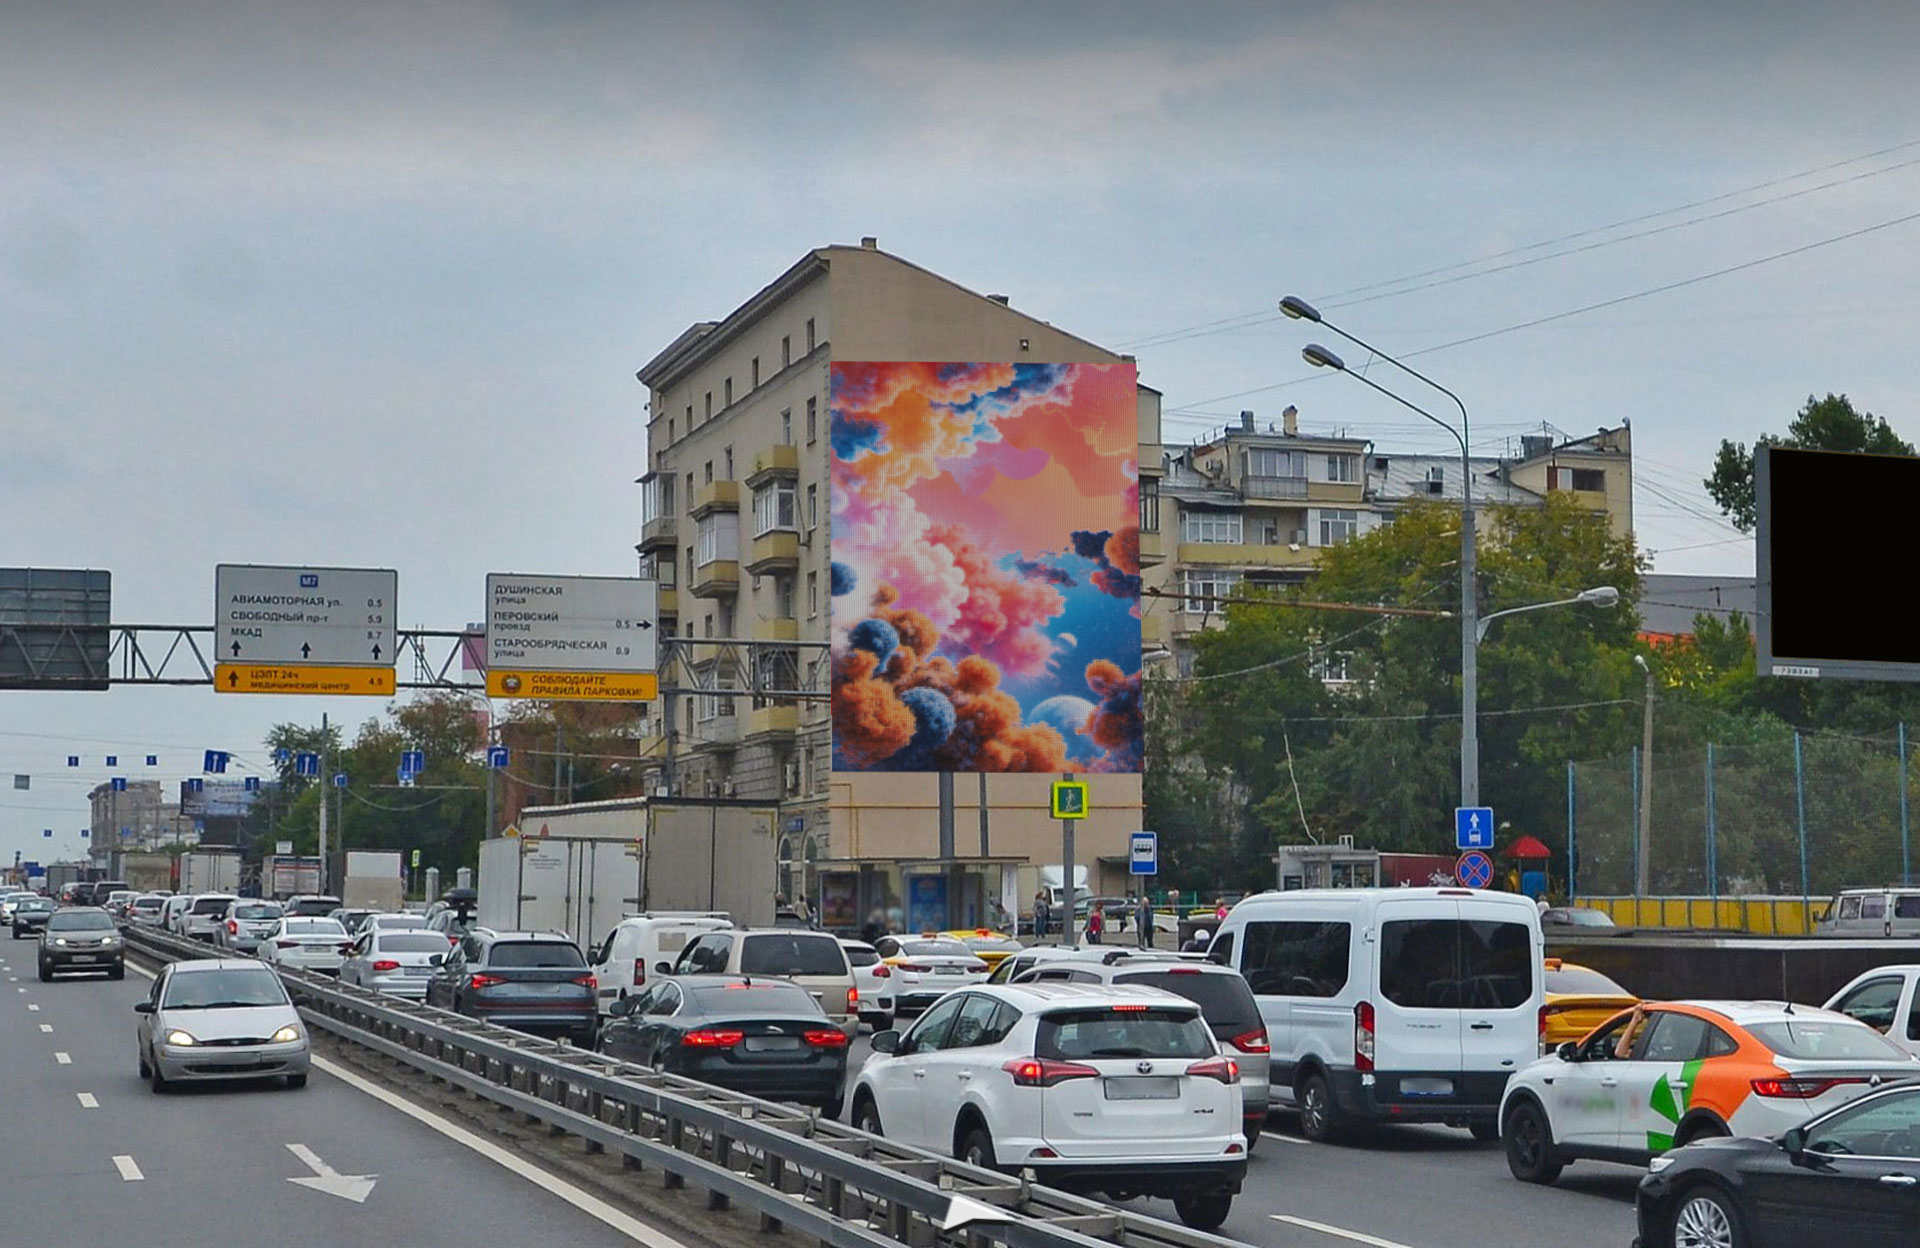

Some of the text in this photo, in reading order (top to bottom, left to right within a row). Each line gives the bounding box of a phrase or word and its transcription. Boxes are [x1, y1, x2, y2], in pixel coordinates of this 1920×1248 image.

[302, 576, 317, 585] М7
[495, 585, 562, 595] ДУШИНСКАЯ
[231, 594, 383, 608] АВИАМОТОРНАЯ ул. 0.5
[496, 597, 526, 605] улица
[231, 611, 304, 622] СВОБОДНЫЙ
[306, 615, 328, 623] пр-т
[494, 611, 559, 621] ПЕРОВСКИЙ
[494, 623, 531, 631] проезд
[615, 619, 630, 629] 0.5
[231, 627, 262, 638] МКАД
[494, 639, 607, 649] СТАРООБРЯДЧЕСКАЯ
[494, 650, 525, 658] улица
[531, 675, 606, 685] СОБЛЮДАЙТЕ
[531, 685, 581, 695] ПРАВИЛА
